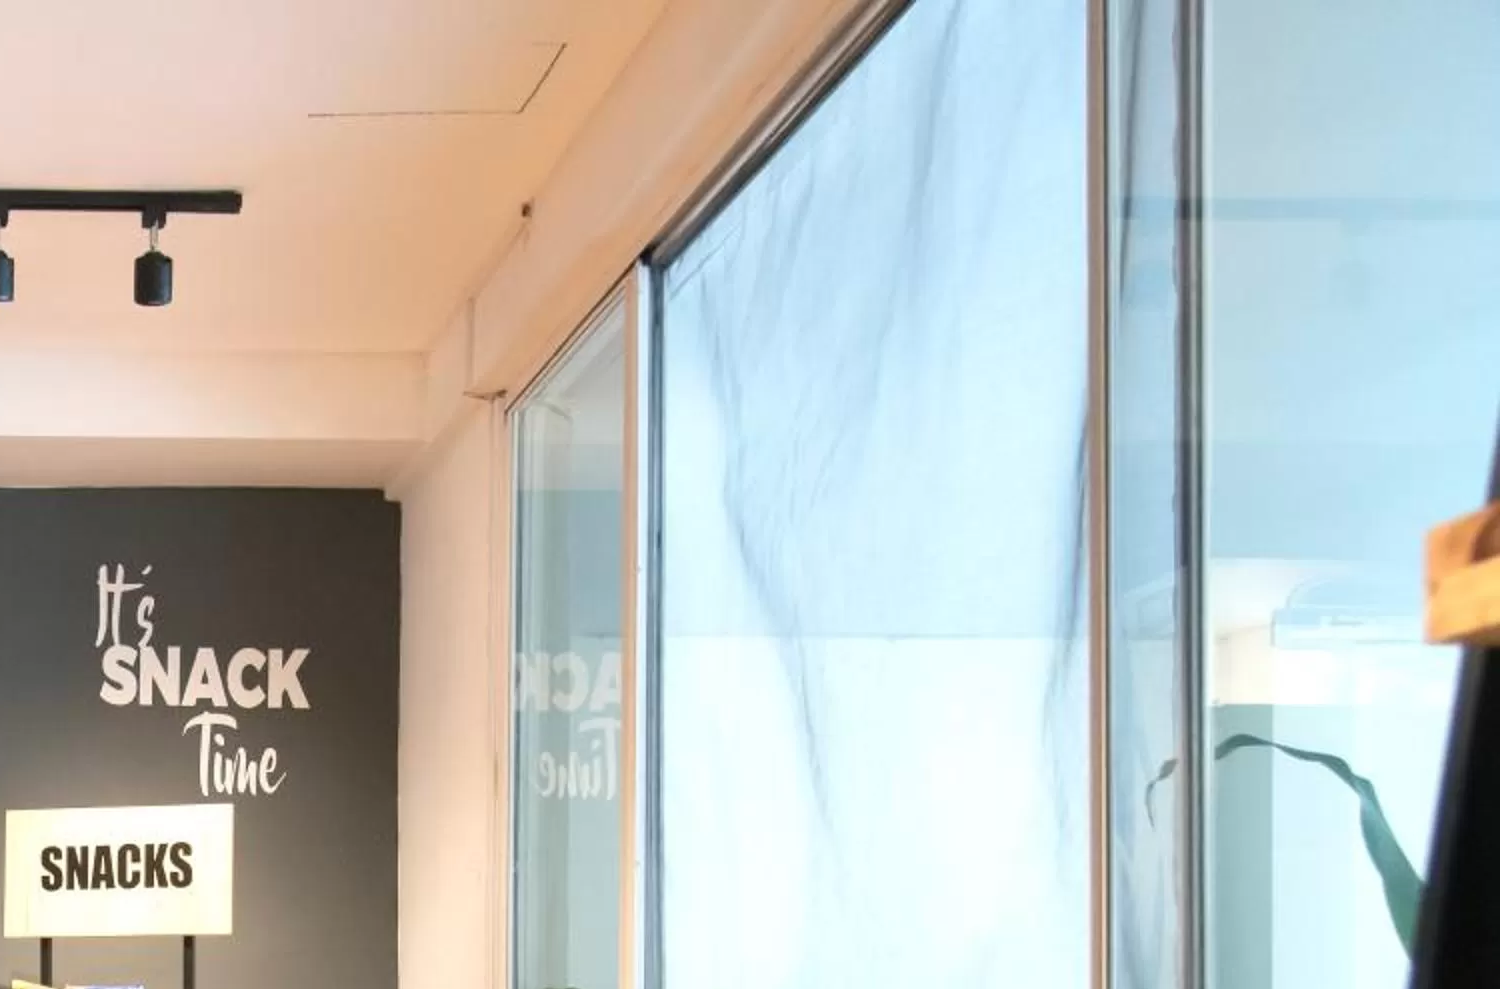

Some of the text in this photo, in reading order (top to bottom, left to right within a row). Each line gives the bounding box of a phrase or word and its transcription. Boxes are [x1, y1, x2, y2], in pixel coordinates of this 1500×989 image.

[96, 563, 155, 649] It's
[100, 645, 311, 709] SNACK
[182, 711, 287, 797] Time
[41, 841, 193, 892] SNACKS
